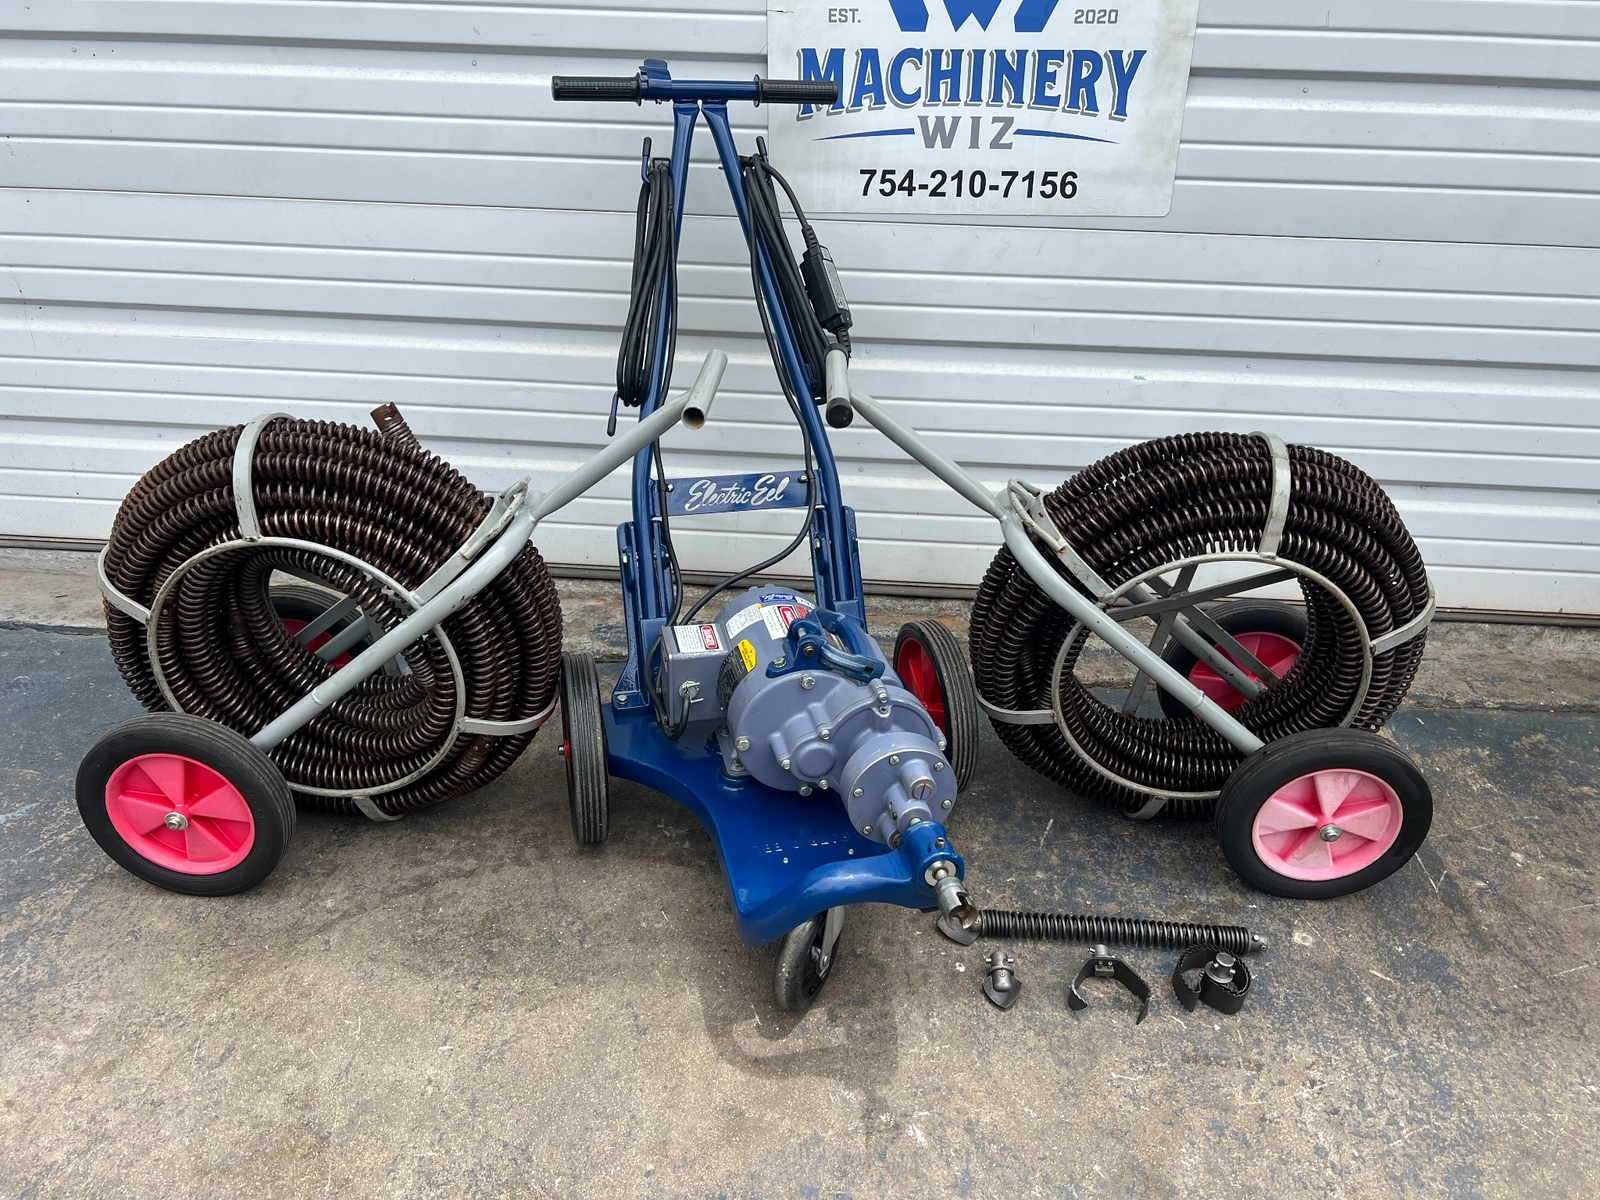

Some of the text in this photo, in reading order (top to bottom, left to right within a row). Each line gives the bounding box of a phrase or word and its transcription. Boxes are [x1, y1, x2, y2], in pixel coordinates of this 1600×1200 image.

[828, 8, 862, 24] EST.
[1073, 9, 1119, 25] 2020
[796, 47, 1148, 122] MACHINERY
[917, 115, 1015, 149] WIZ
[859, 169, 1079, 199] 754-210-7156
[684, 474, 790, 511] Electric Eel
